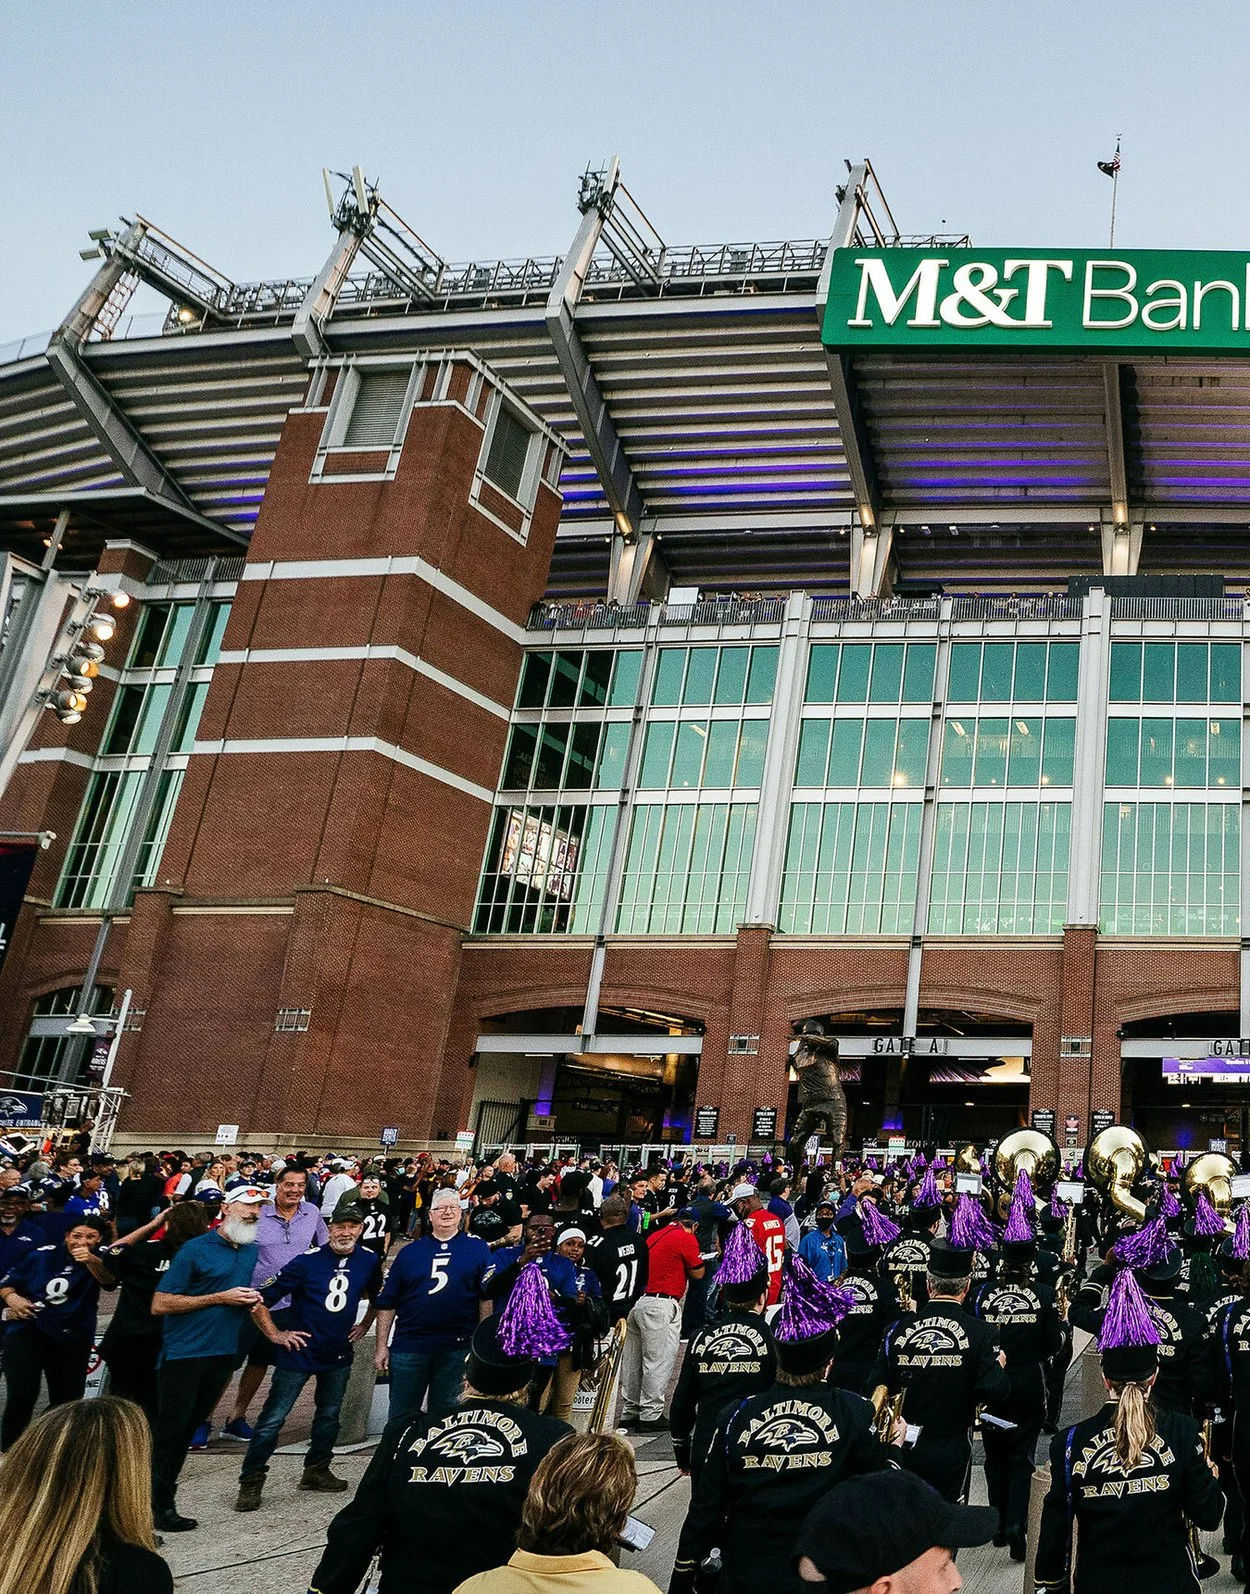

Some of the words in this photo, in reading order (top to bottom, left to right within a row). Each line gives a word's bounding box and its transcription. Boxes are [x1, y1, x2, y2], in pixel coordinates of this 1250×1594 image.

[846, 259, 1072, 330] M&T
[874, 1037, 916, 1054] GATE
[929, 1038, 938, 1053] A
[0, 1119, 14, 1127] UITE
[15, 1119, 42, 1127] ENTRAN
[363, 1213, 387, 1240] 22
[618, 1243, 635, 1257] WEBB
[766, 1235, 784, 1273] 15
[428, 1258, 450, 1295] 5
[612, 1259, 638, 1301] 21
[888, 1262, 928, 1273] RAVENS
[46, 1277, 69, 1305] 8
[324, 1273, 350, 1312] 8
[985, 1313, 1037, 1324] RAVENS
[696, 1323, 768, 1357] BALTIMORE
[894, 1316, 970, 1351] BALTIMORE
[698, 1361, 761, 1376] RAVENS
[897, 1355, 963, 1369] RAVENS
[408, 1409, 528, 1458] BALTIMORE
[737, 1400, 841, 1448] BALTIMORE
[741, 1451, 833, 1472] RAVENS
[1072, 1427, 1176, 1479] BALTRE
[408, 1465, 517, 1487] RAVENS
[1080, 1475, 1170, 1499] RAVENS
